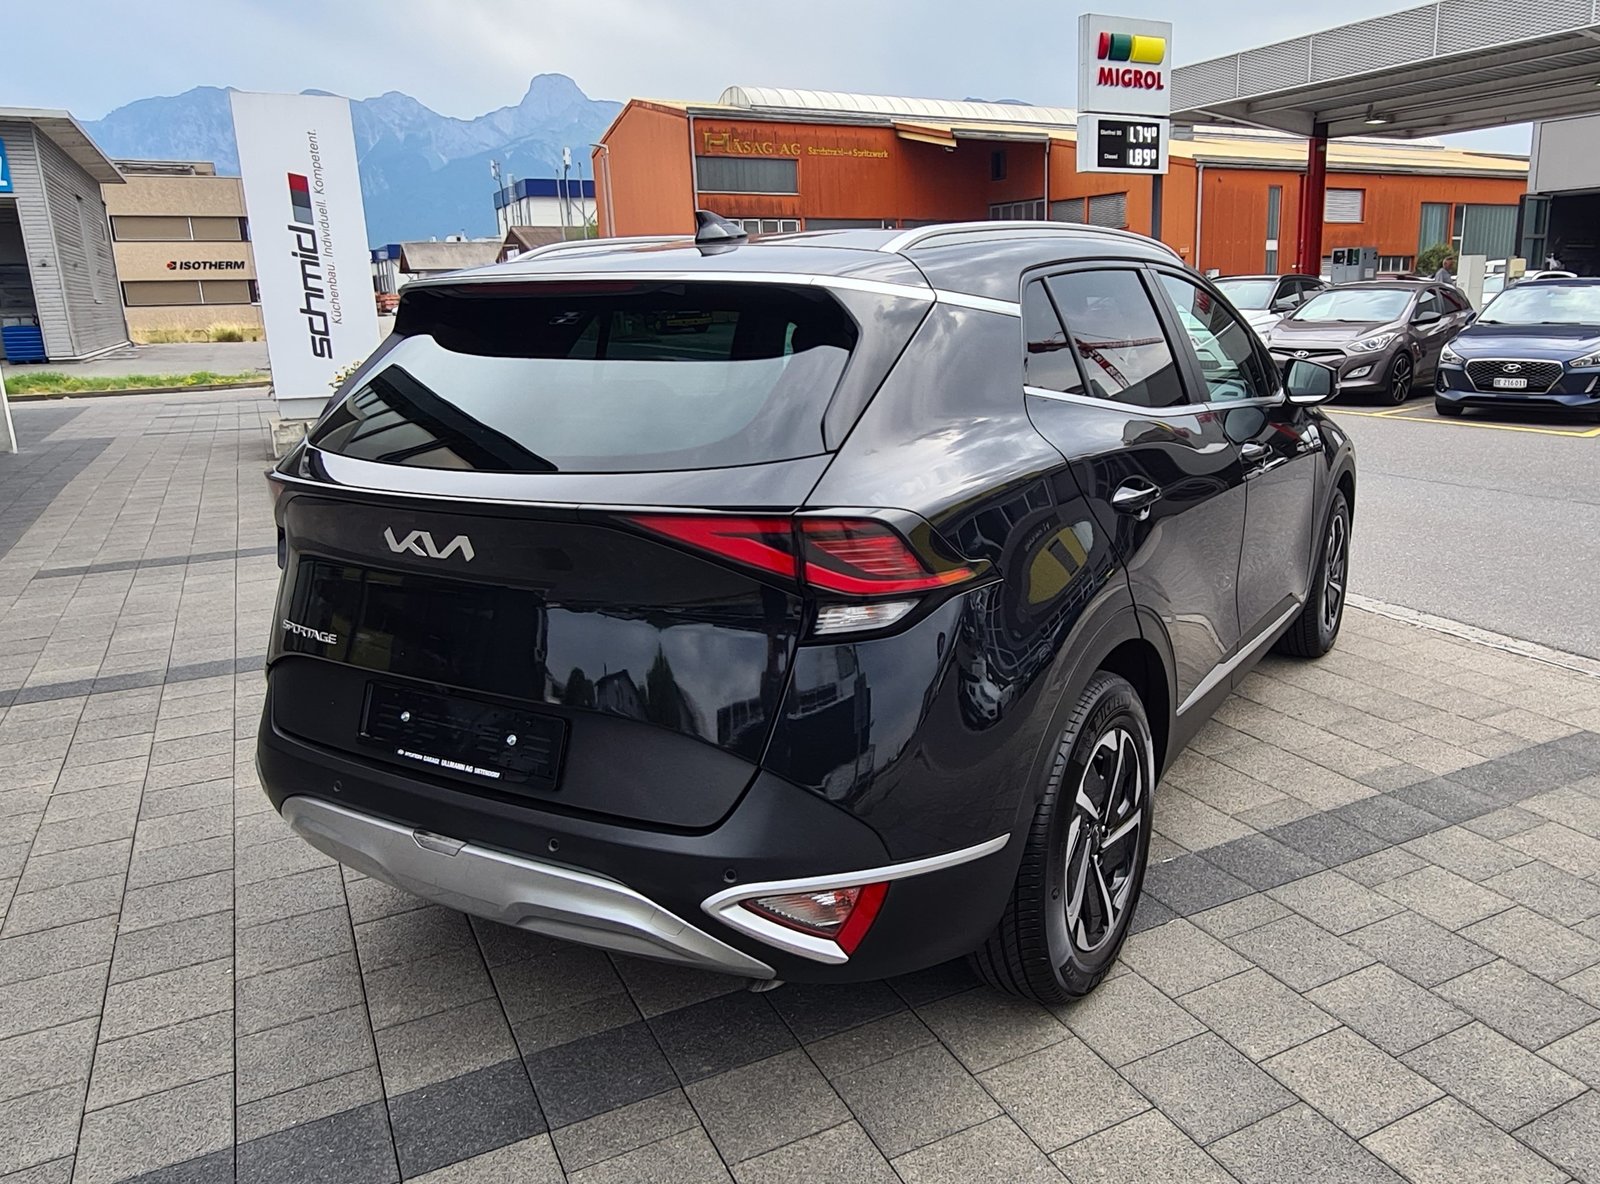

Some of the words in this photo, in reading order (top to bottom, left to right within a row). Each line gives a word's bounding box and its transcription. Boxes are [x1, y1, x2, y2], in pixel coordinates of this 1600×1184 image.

[1097, 67, 1164, 90] MIGROL
[307, 129, 325, 195] Kompetent.
[779, 143, 801, 155] AG
[318, 199, 334, 257] Individuell.
[180, 261, 245, 270] ISOTHERM
[287, 225, 333, 359] schmid
[323, 262, 342, 325] Küchenbau.
[383, 526, 475, 562] KIA
[283, 619, 337, 645] SPORTAGE
[465, 764, 474, 773] AG
